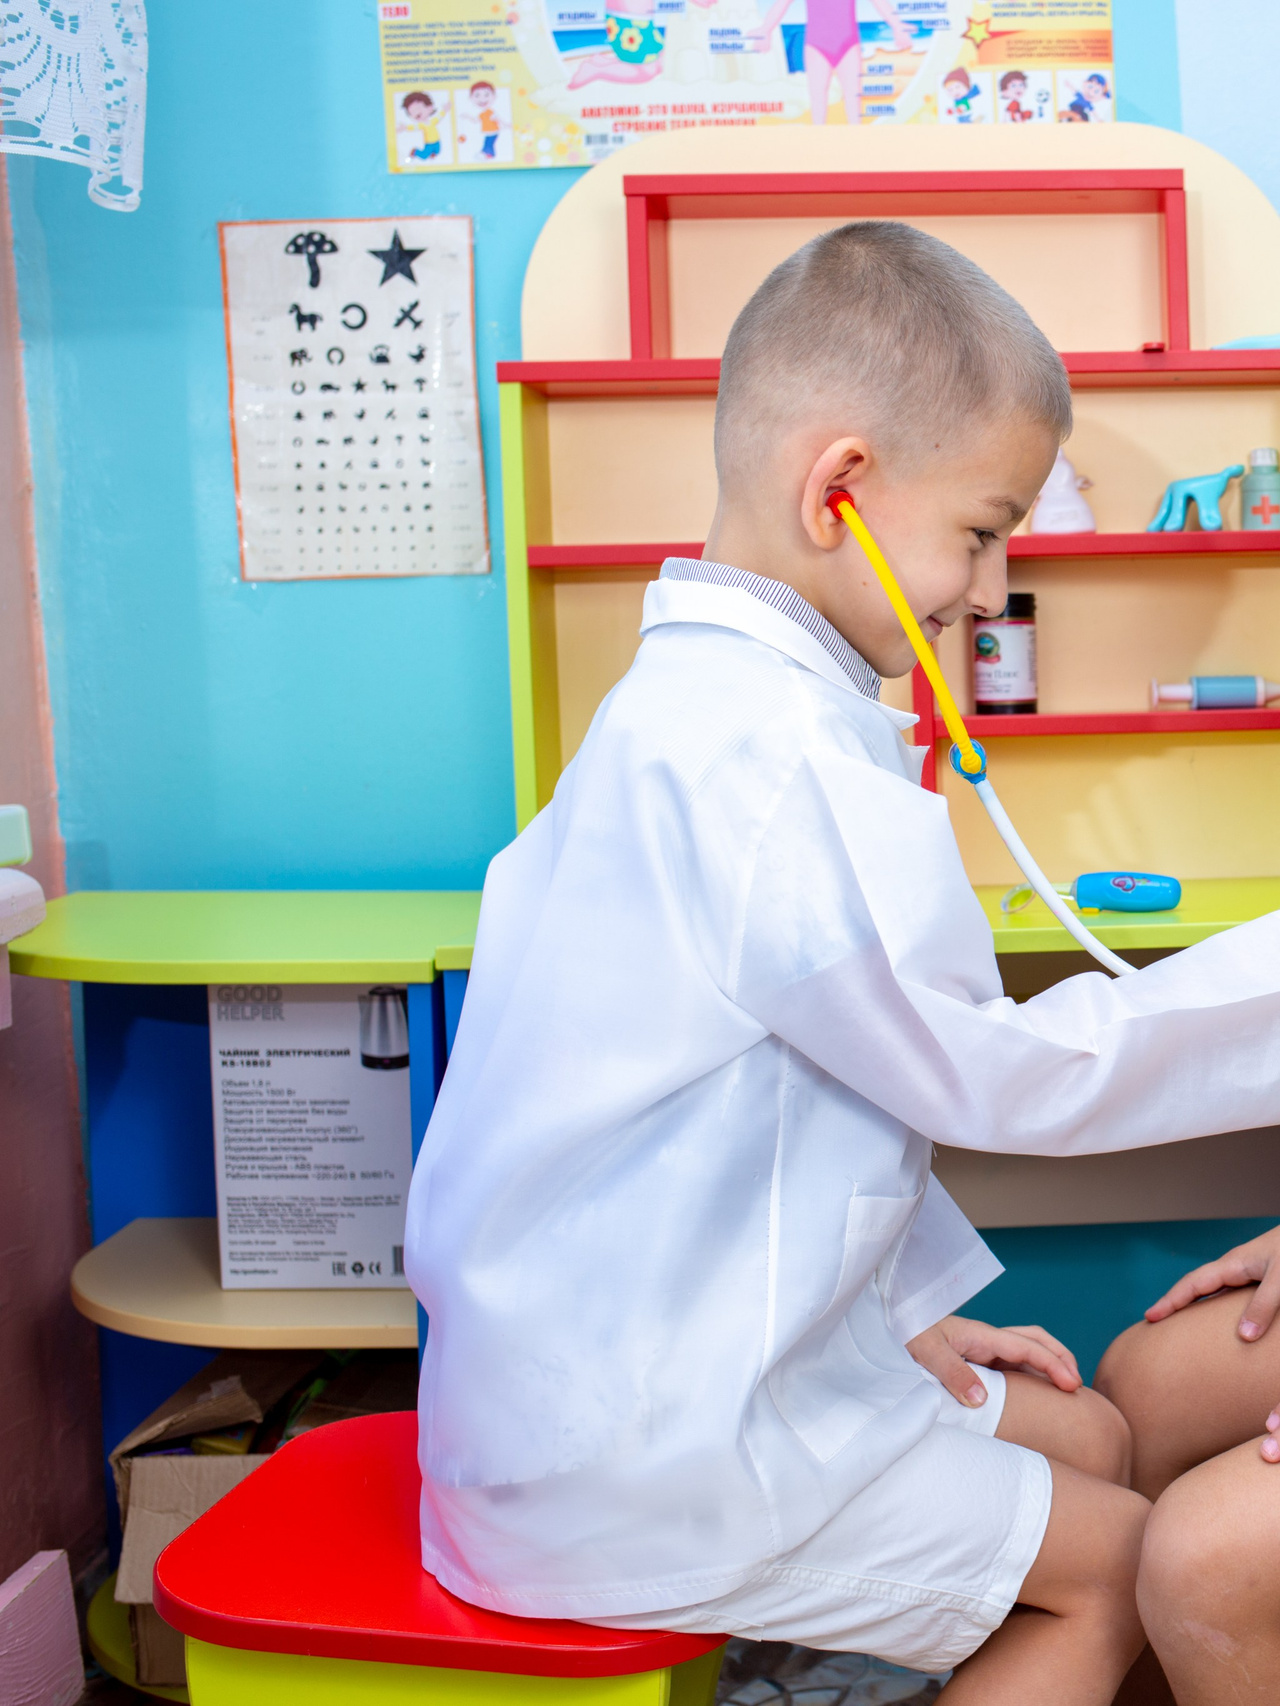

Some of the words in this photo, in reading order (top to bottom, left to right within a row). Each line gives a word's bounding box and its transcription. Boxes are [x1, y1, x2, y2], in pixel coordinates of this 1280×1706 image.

[217, 985, 283, 1002] GOOD
[217, 1003, 285, 1021] HELPER
[219, 1048, 260, 1057] ЧАЙНИК
[265, 1048, 351, 1057] ЭЛЕКТРИЧЕСКИЙ
